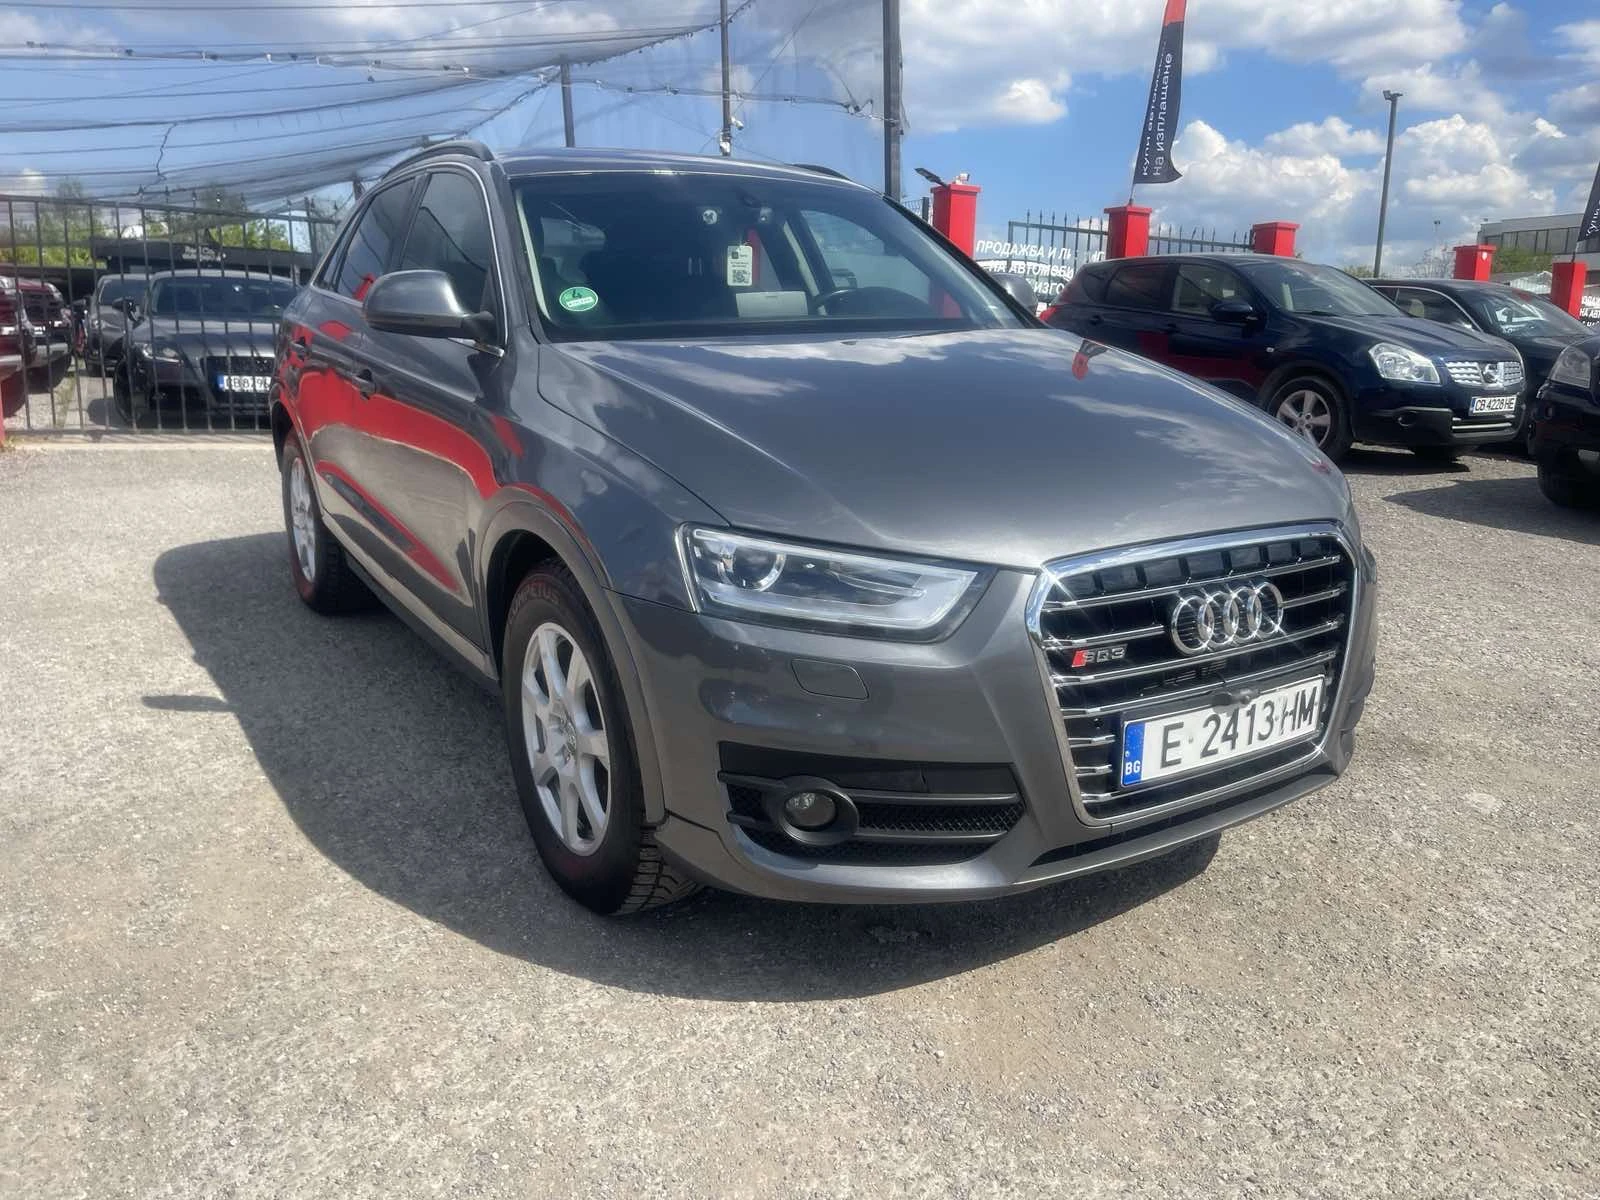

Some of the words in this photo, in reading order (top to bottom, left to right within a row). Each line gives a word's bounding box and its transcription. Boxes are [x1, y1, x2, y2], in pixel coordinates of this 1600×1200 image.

[1156, 53, 1173, 152] изплащане
[976, 240, 1045, 258] ПРОДАЖБА
[1160, 721, 1185, 769] E
[1200, 700, 1275, 759] 2413
[1279, 686, 1318, 735] HM
[1125, 760, 1141, 776] BG
